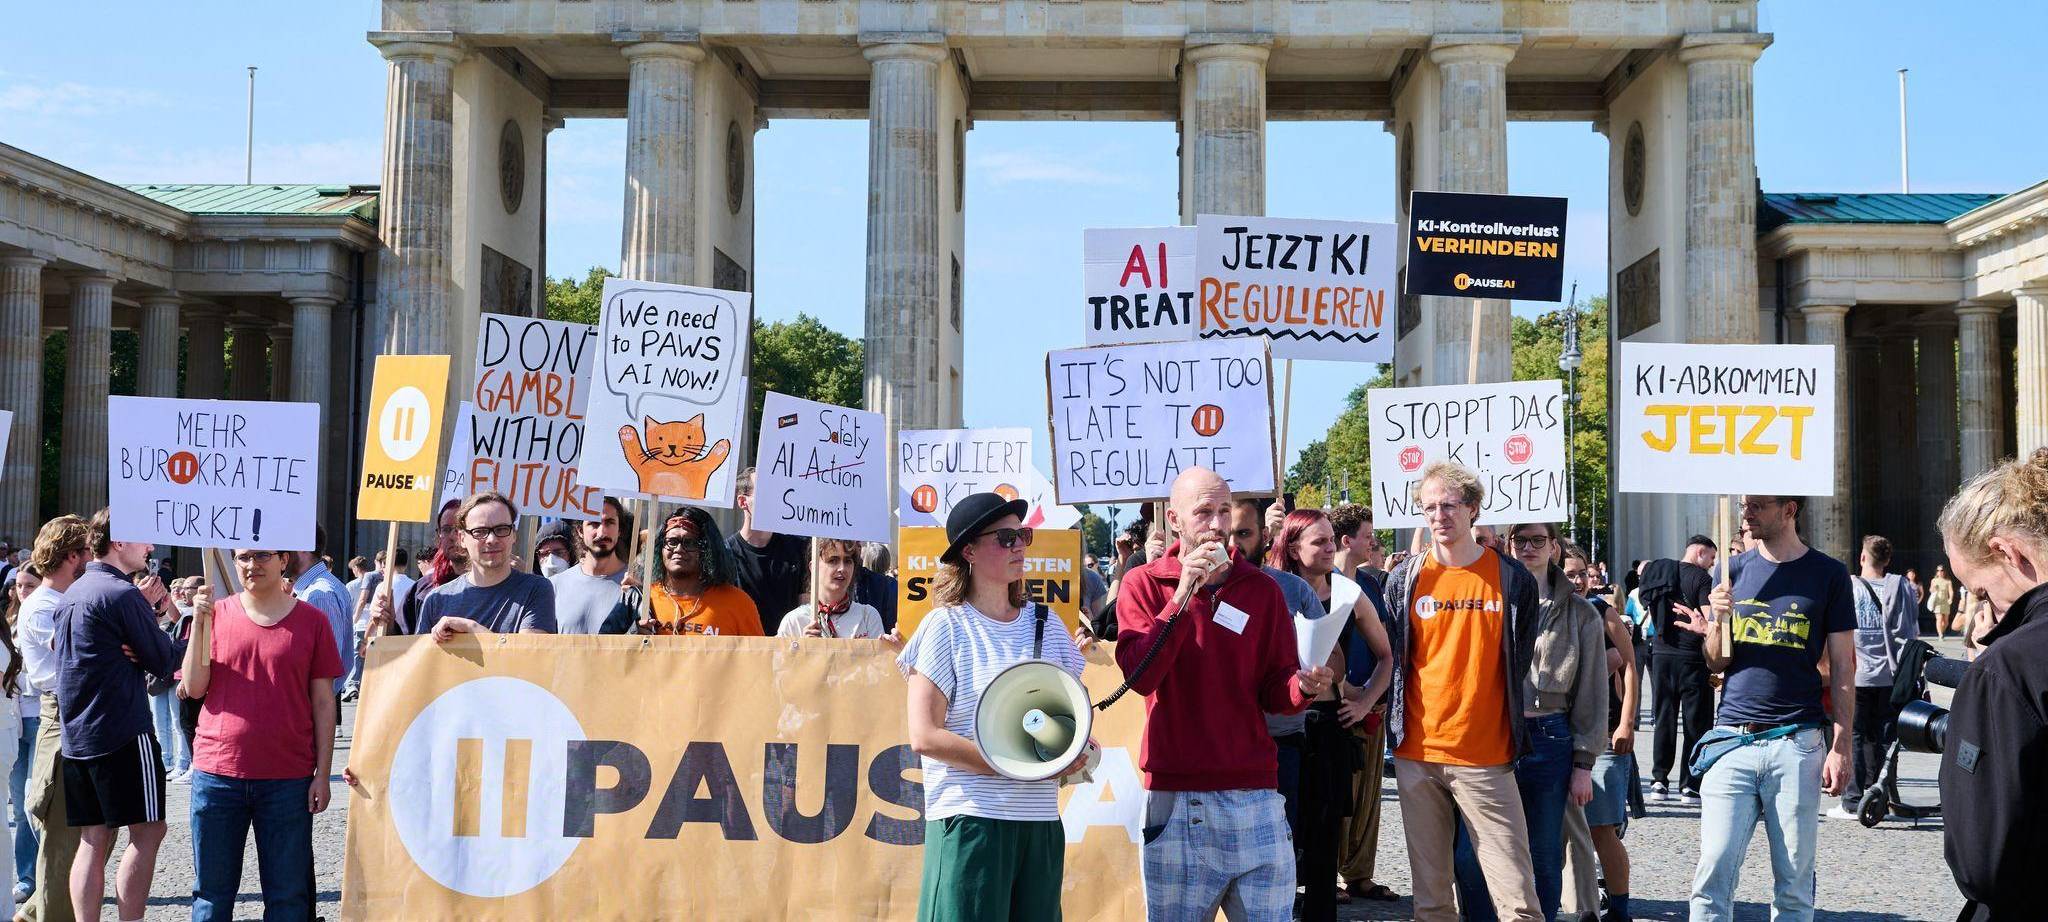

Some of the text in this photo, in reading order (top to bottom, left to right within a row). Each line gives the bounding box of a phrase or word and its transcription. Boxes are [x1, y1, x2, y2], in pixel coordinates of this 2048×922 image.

[1416, 236, 1558, 258] VERHINDERN
[1418, 219, 1559, 238] KI-Kontrollverlust
[1120, 242, 1168, 289] AI
[1222, 226, 1370, 276] JETZT KI
[619, 298, 719, 330] We need
[1199, 276, 1385, 330] REGULIEREN
[612, 330, 721, 361] to PAWS
[476, 369, 584, 420] GAMBL
[618, 363, 719, 391] AI NOW!
[1061, 353, 1262, 399] IT'S NOT TOO
[1636, 364, 1816, 396] KI-ABKOMMEN
[177, 411, 246, 448] MEHR
[819, 409, 869, 459] Safety
[1066, 405, 1142, 442] LATE
[1385, 394, 1558, 442] STOPPT DAS
[1641, 404, 1816, 461] JETZT
[471, 414, 585, 464] WITHO
[902, 441, 1028, 474] REGULIERT
[366, 473, 431, 491] PAUSEAI
[772, 442, 862, 488] AI Action
[1070, 447, 1234, 487] REGULATE
[471, 457, 601, 516] FUTURE
[156, 499, 201, 537] FÜR
[782, 488, 852, 527] Summit
